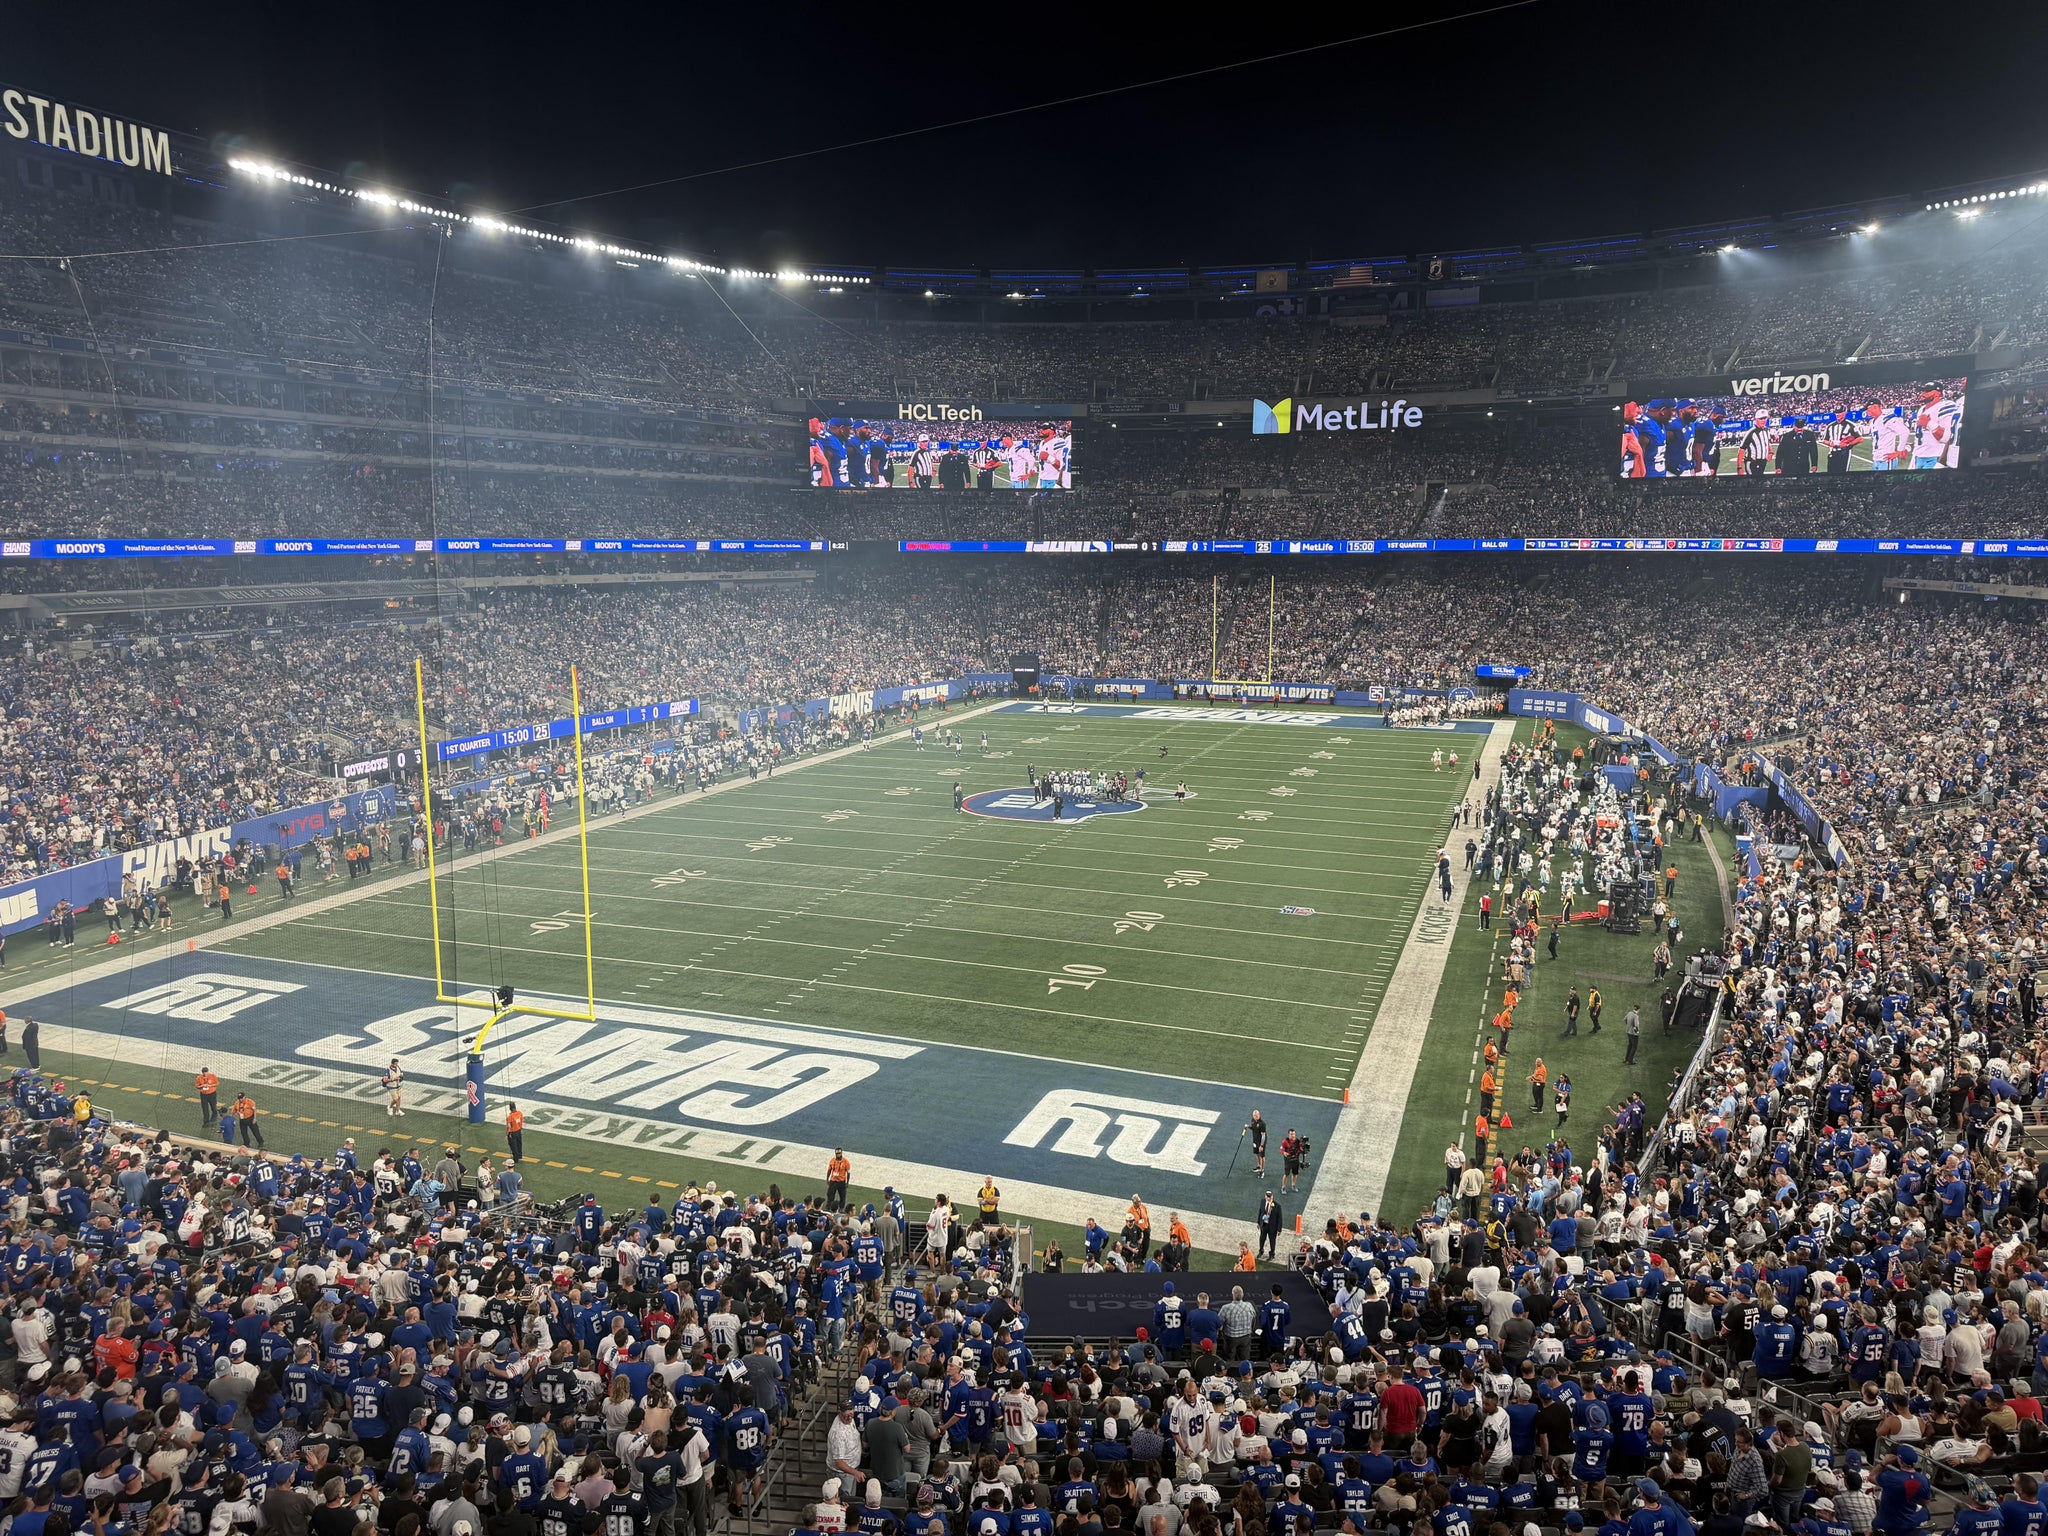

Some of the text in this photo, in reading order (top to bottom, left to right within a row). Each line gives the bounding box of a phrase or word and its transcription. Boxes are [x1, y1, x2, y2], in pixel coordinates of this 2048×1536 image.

[3, 89, 172, 176] STADIUM
[1731, 371, 1830, 396] verizon
[898, 403, 983, 421] HCLTech
[1295, 400, 1423, 431] MetLife
[3, 542, 30, 554] GIANTS
[56, 543, 106, 554] MOODY'S
[234, 542, 256, 551] GIANTS
[275, 542, 313, 552] MOODY'S
[448, 541, 480, 549] MOODY'S
[594, 541, 622, 549] MOODY'S
[1257, 543, 1269, 551] 25
[1302, 543, 1334, 551] MetLife
[1349, 542, 1373, 551] 15:00
[1815, 540, 1838, 550] GIANTS
[1878, 542, 1899, 550] MOODY'S
[1983, 543, 2008, 552] MOODY'S
[220, 587, 325, 600] METLIFE STADIUM
[1205, 685, 1329, 699] YORK GIANTS
[1371, 688, 1382, 697] 25
[669, 700, 691, 714] GIANTS
[829, 691, 874, 716] GIANTS
[652, 707, 659, 718] 0
[1130, 707, 1342, 726] GIANTS
[592, 715, 614, 726] BALL ON
[502, 728, 529, 745] 15:00
[535, 725, 548, 738] 25
[445, 738, 491, 755] 1ST QUARTER
[343, 757, 388, 778] COWBOYS
[397, 753, 405, 767] 0
[282, 813, 324, 838] NYG
[745, 835, 793, 849] 30
[123, 825, 232, 894] GIANTS
[650, 868, 706, 884] 20
[1164, 869, 1209, 886] 30
[530, 909, 598, 930] 10
[1113, 910, 1166, 932] 20
[1414, 906, 1454, 945] KICKOFF
[1049, 963, 1107, 991] 10
[295, 1005, 882, 1127] GIANTS
[247, 1063, 310, 1087] US
[320, 1077, 390, 1098] OF
[523, 1107, 699, 1150] TAKES
[1682, 1130, 1694, 1143] 88
[716, 1140, 787, 1164] IT
[335, 1158, 346, 1168] 27
[256, 1167, 274, 1181] 10
[377, 1179, 392, 1194] 33
[182, 1211, 194, 1225] 44
[585, 1217, 593, 1230] 6
[676, 1211, 691, 1226] 56
[235, 1222, 250, 1239] 21
[308, 1226, 321, 1239] 13
[17, 1254, 27, 1270] 6
[858, 1248, 877, 1263] 89
[1955, 1267, 1973, 1275] TAYLOR
[410, 1282, 421, 1296] 13
[1333, 1279, 1345, 1291] 13
[1401, 1278, 1409, 1289] 6
[895, 1290, 917, 1300] STRAHAN
[1667, 1293, 1684, 1309] 88
[894, 1301, 916, 1319] 92
[1744, 1308, 1759, 1316] TAYLOR
[1164, 1313, 1180, 1328] 56
[1273, 1315, 1278, 1331] 1
[1744, 1317, 1759, 1330] 56
[714, 1328, 725, 1344] 11
[1347, 1320, 1364, 1340] 44
[261, 1345, 272, 1362] 13
[768, 1344, 782, 1363] 10
[1776, 1342, 1784, 1357] 1
[1865, 1343, 1883, 1361] 56
[290, 1383, 307, 1403] 10
[355, 1385, 375, 1394] PATRICK
[485, 1379, 508, 1400] 72
[539, 1382, 566, 1404] 94
[1558, 1388, 1573, 1401] DART
[353, 1397, 377, 1419] 25
[1426, 1391, 1441, 1410] 10
[1623, 1404, 1644, 1412] THOMAS
[857, 1413, 865, 1431] 1
[975, 1407, 986, 1426] 3
[1005, 1408, 1022, 1427] 10
[1352, 1411, 1373, 1430] 10
[1622, 1412, 1644, 1432] 78
[1188, 1414, 1205, 1436] 89
[1702, 1427, 1718, 1438] CARTER
[735, 1427, 759, 1450] 88
[1589, 1439, 1604, 1447] DART
[1711, 1436, 1731, 1461] 17
[212, 1464, 227, 1474] 88
[389, 1450, 411, 1474] 72
[516, 1465, 530, 1473] DART
[30, 1461, 57, 1488] 17
[517, 1478, 531, 1498] 6
[1346, 1490, 1364, 1498] TAYLOR
[51, 1503, 73, 1514] TAYLOR
[611, 1505, 627, 1513] LAMB
[2028, 1512, 2043, 1520] DART
[1446, 1512, 1460, 1522] CRUZ
[605, 1516, 634, 1536] 88
